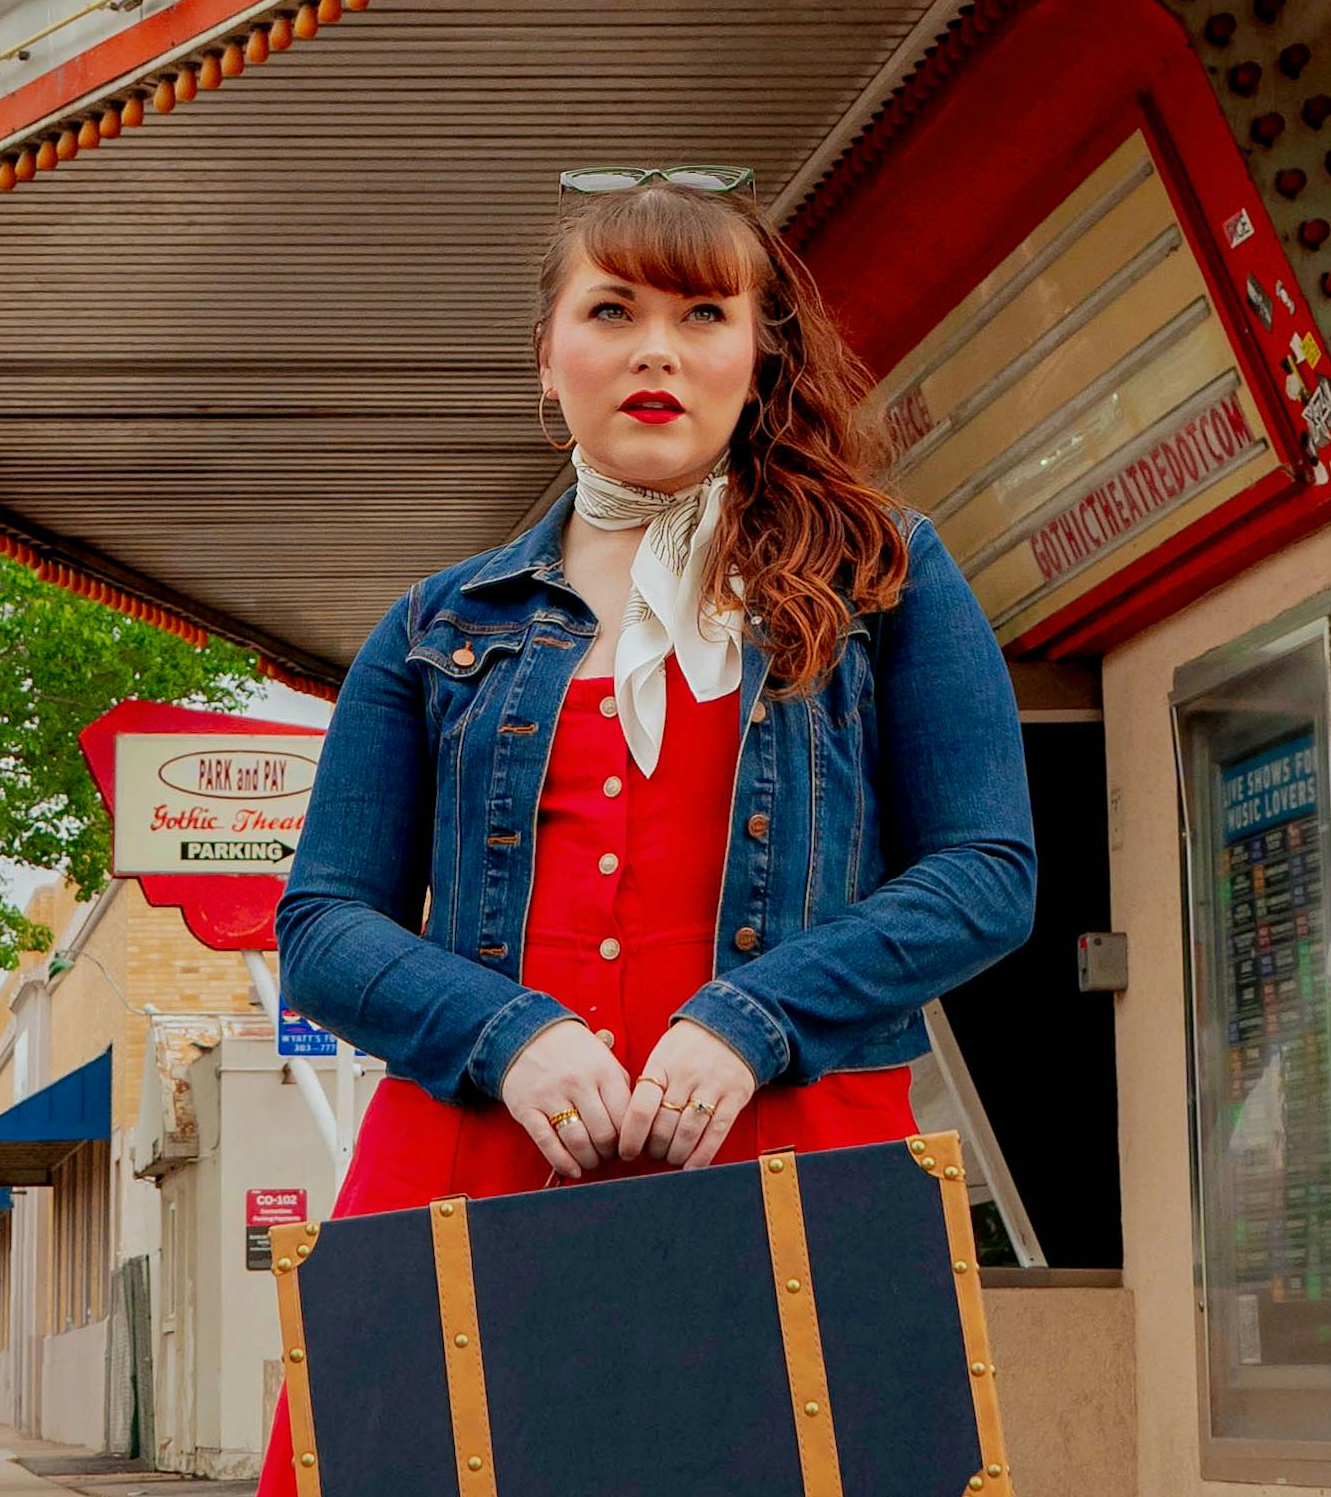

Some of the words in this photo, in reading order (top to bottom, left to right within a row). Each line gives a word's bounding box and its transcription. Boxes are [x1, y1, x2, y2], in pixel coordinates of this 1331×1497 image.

[1029, 390, 1255, 581] GOTHICTHEATREDOTCOM
[199, 759, 232, 791] PARK
[237, 760, 259, 791] and
[264, 760, 287, 792] PAY
[1248, 757, 1290, 793] SHOWS
[1266, 778, 1317, 819] LOVERS
[150, 804, 221, 832] Gothic
[186, 841, 284, 861] PARKING
[256, 1194, 298, 1206] CO-102
